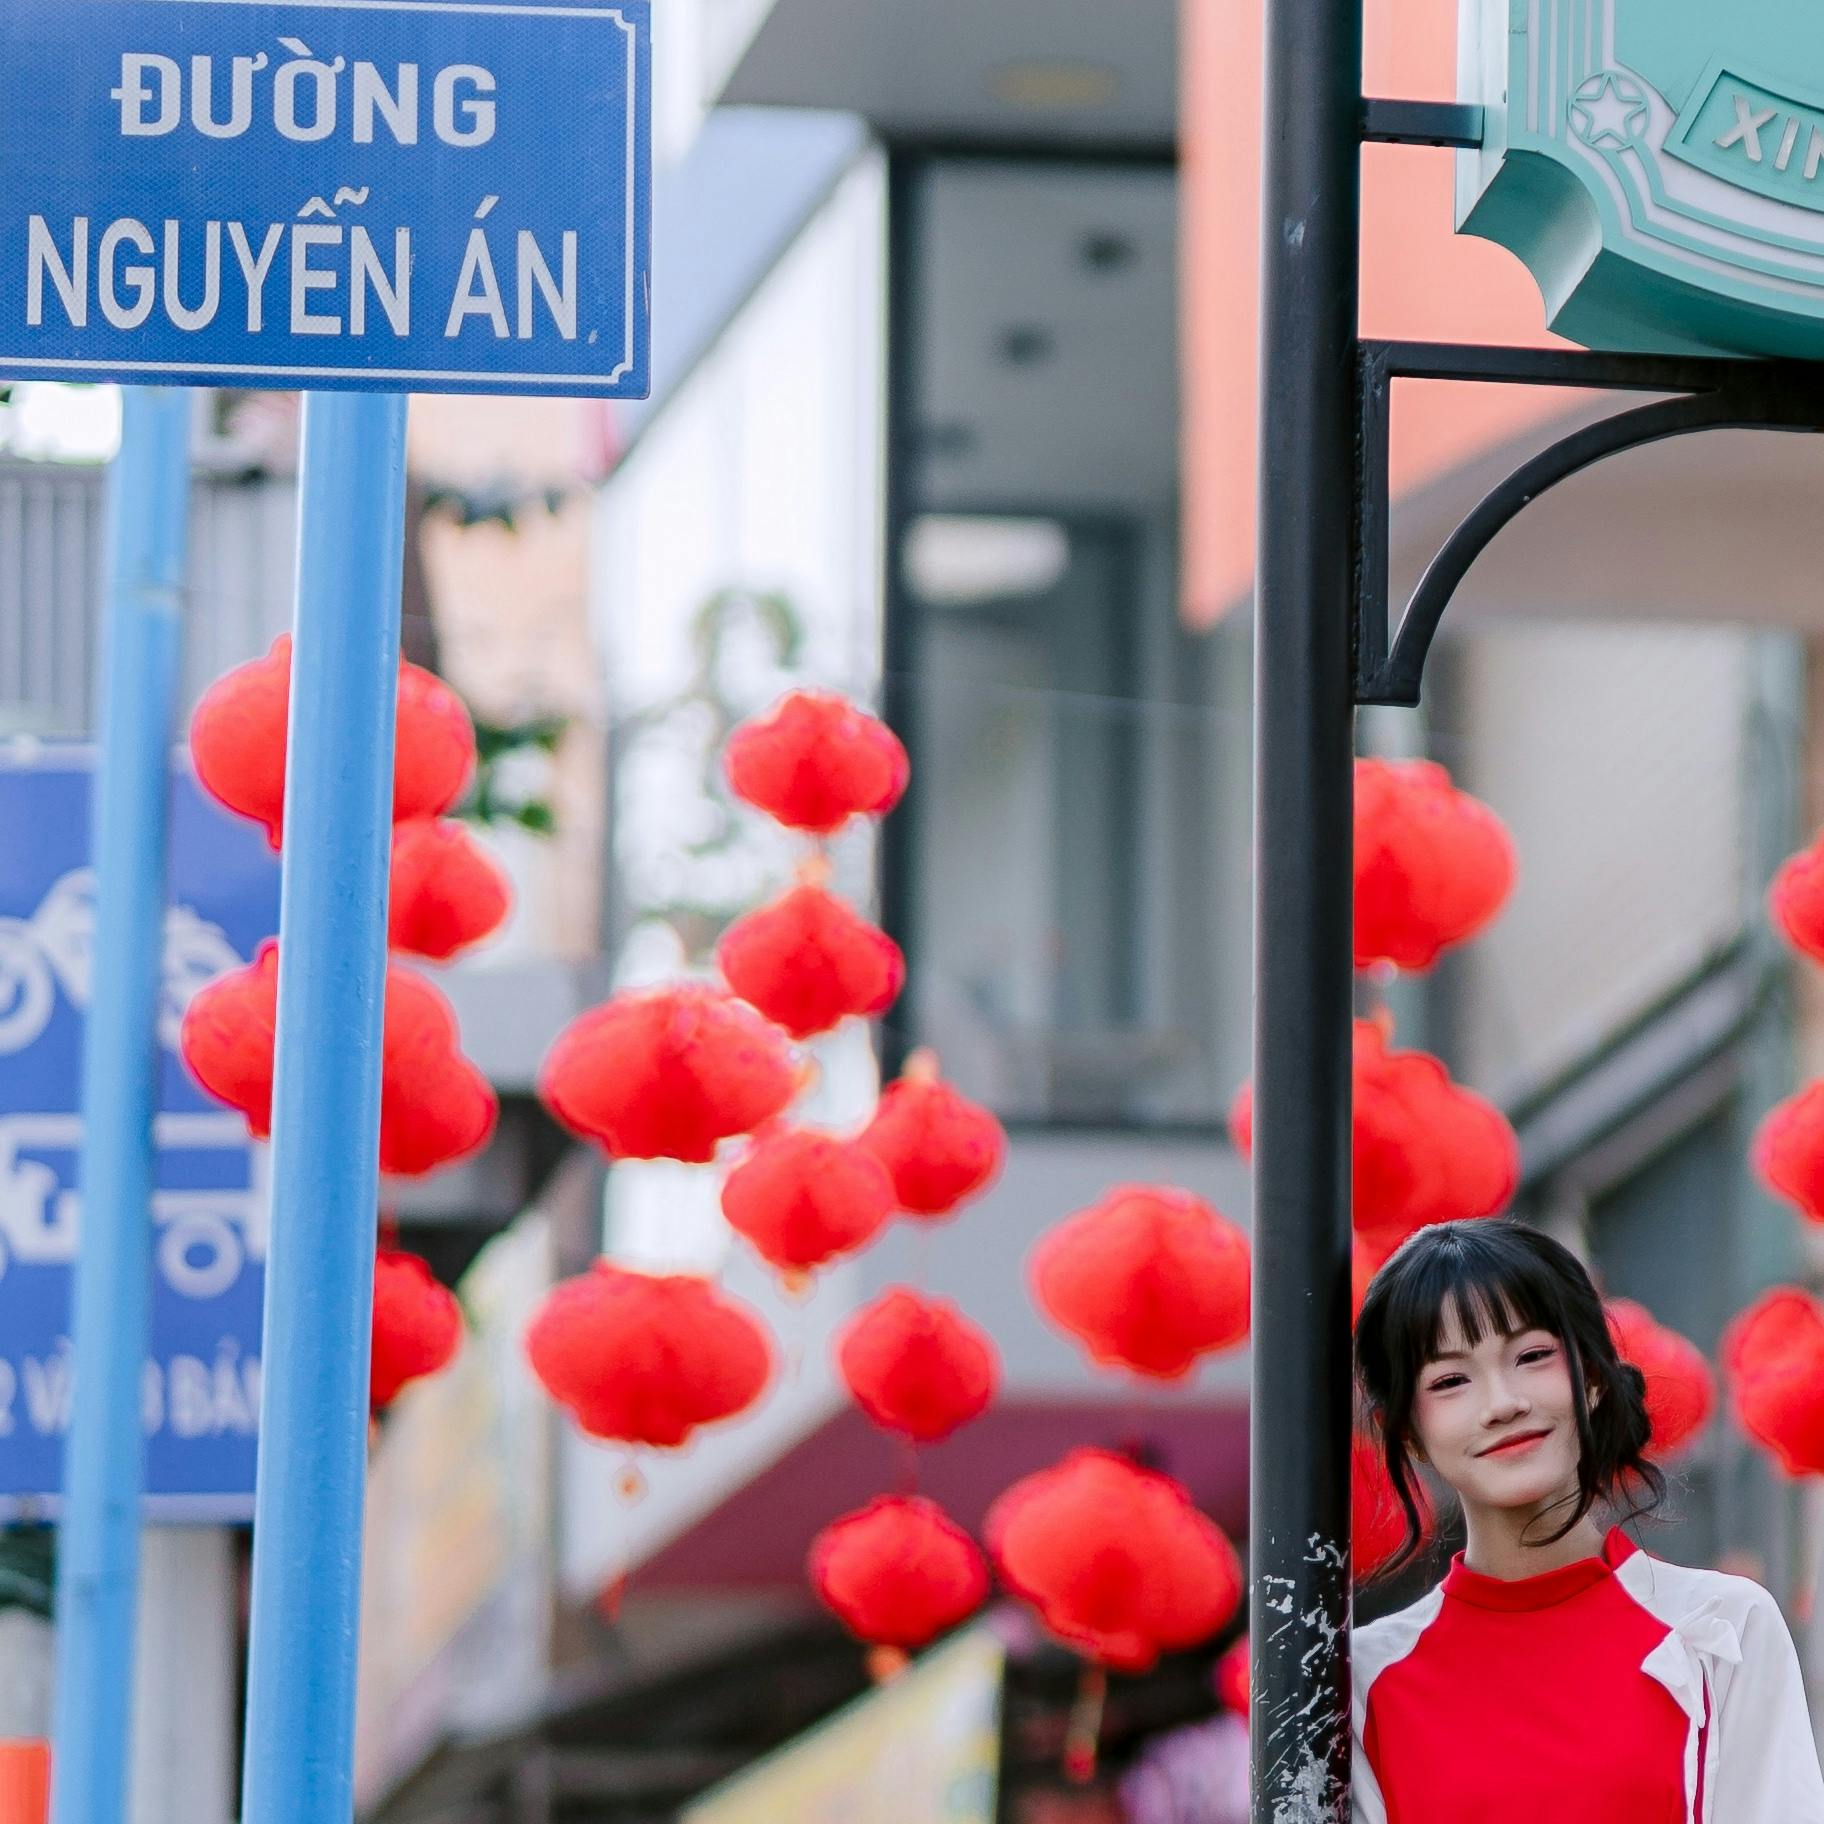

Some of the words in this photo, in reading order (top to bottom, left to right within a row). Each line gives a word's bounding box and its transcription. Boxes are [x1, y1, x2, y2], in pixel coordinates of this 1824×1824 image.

[111, 36, 498, 147] ĐƯỜNG
[26, 185, 411, 337] NGUYỄN
[443, 195, 579, 341] ÁN
